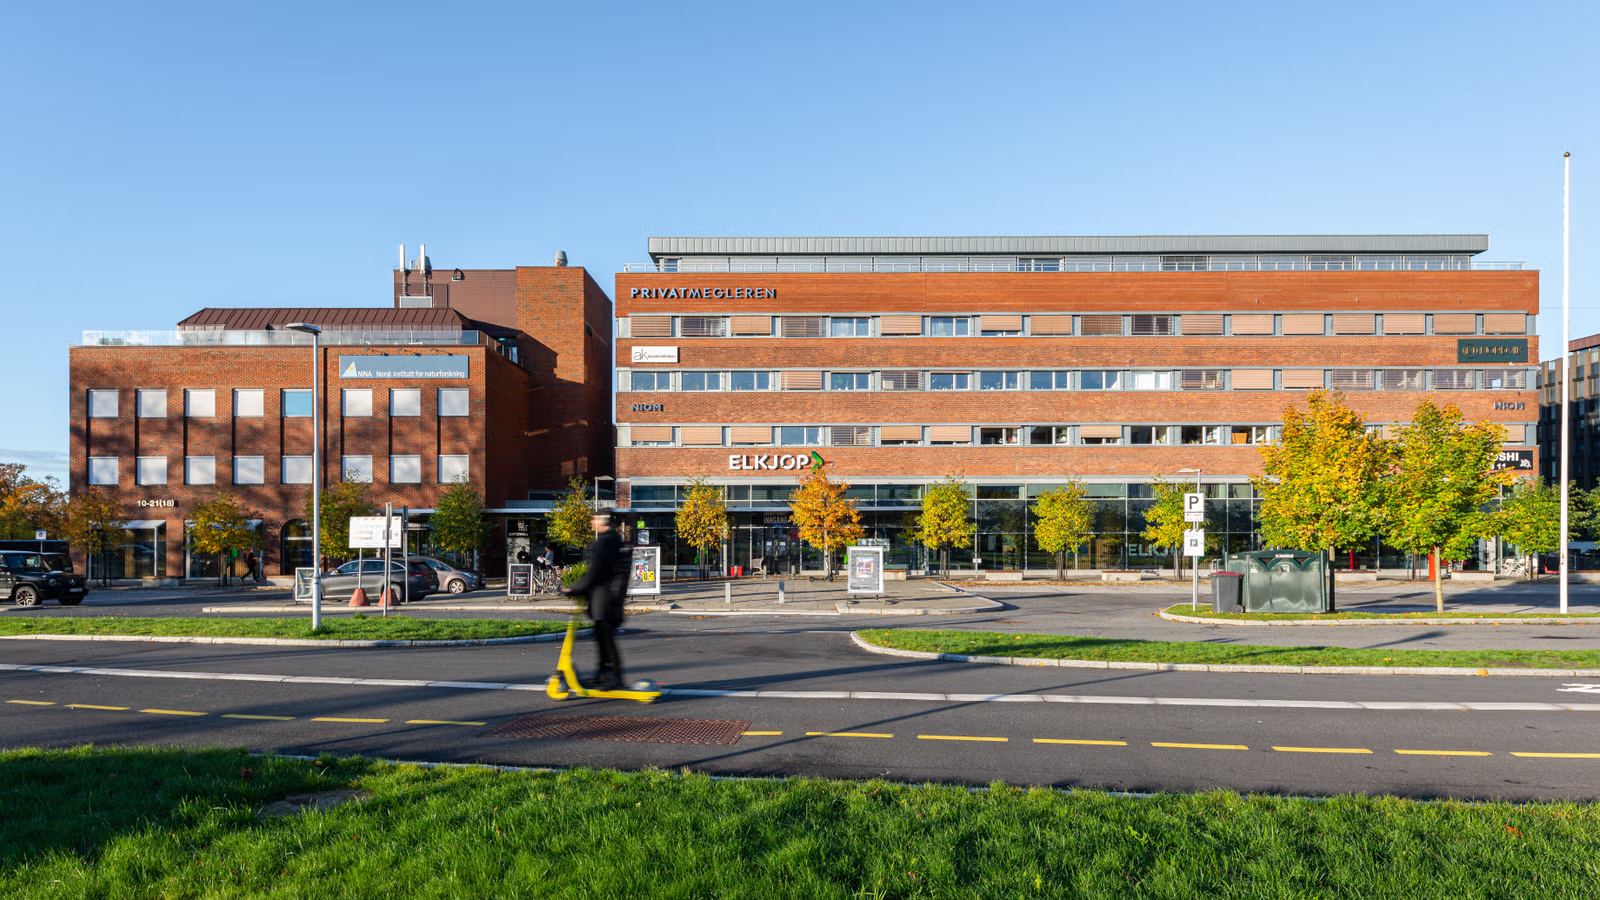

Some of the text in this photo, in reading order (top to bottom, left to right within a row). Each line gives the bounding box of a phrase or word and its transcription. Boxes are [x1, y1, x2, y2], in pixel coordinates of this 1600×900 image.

[630, 287, 777, 299] PRIVATMEGLEREN
[631, 403, 664, 412] NIOM
[137, 499, 174, 507] 10-21(18)
[1188, 495, 1199, 510] P
